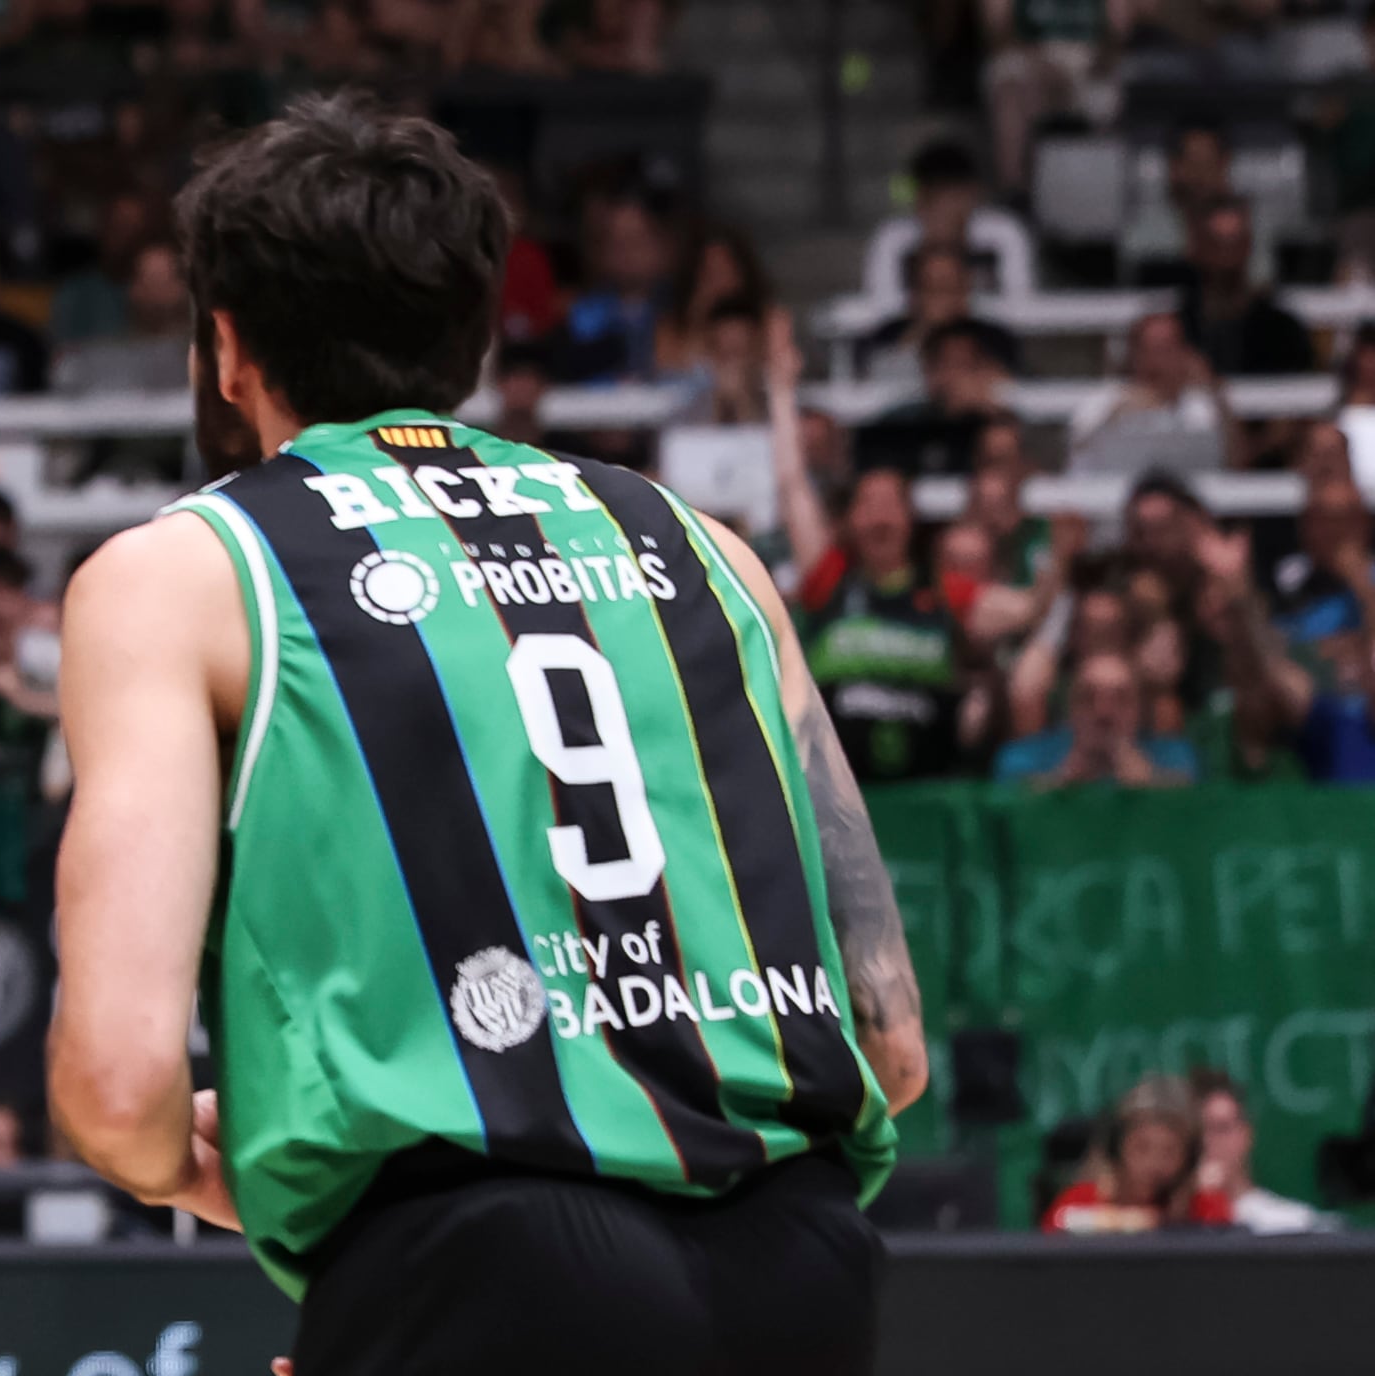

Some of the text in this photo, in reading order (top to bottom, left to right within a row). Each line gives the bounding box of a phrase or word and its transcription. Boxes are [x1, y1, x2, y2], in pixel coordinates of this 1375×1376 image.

[303, 462, 602, 531] RICKY
[449, 551, 677, 607] PROBITAS
[505, 633, 666, 901] 9
[533, 919, 662, 980] City of
[547, 963, 841, 1040] BADALONA
